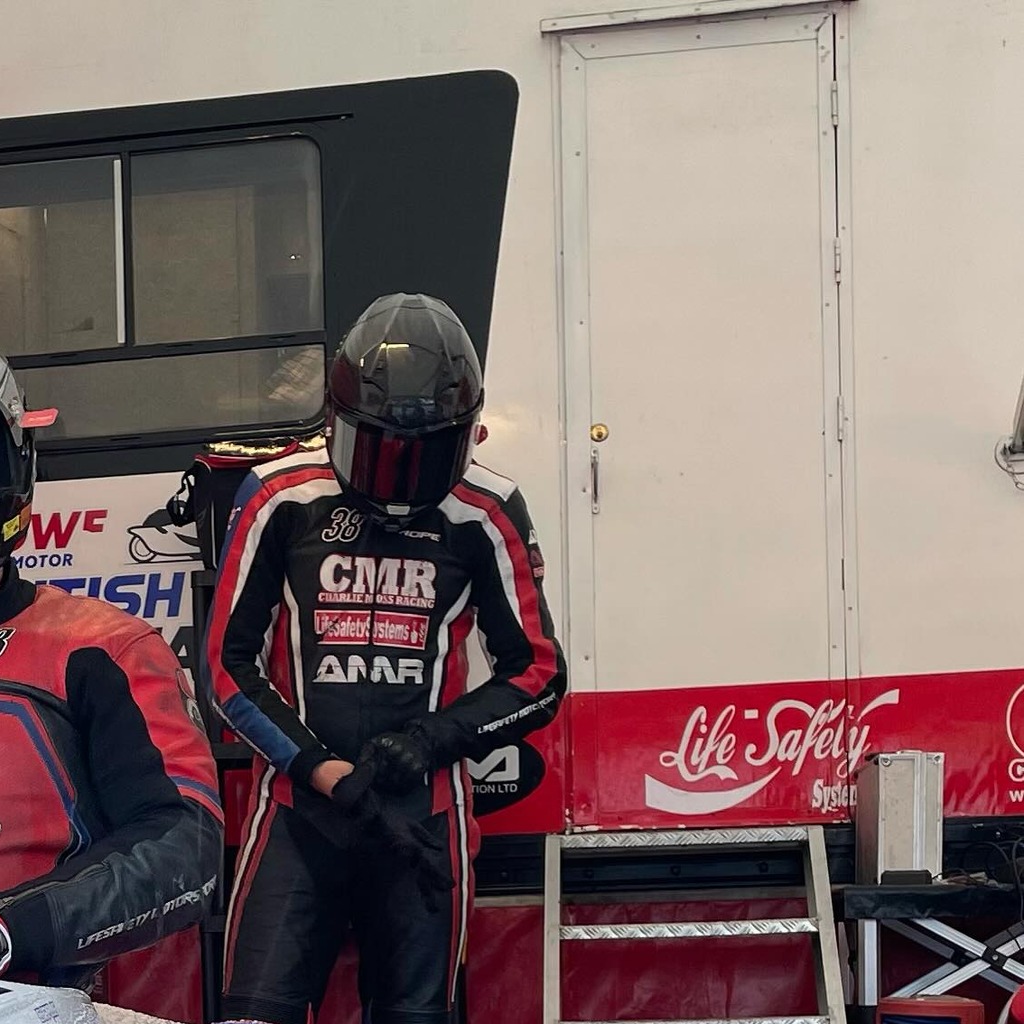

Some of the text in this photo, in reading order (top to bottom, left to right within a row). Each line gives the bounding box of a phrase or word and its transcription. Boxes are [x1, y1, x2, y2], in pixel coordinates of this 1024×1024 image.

[321, 507, 364, 542] 38
[319, 554, 437, 599] CMR
[36, 571, 186, 618] TISH
[318, 592, 436, 609] CHARLIE MOSS RACING
[312, 654, 425, 685] AMR
[497, 783, 518, 793] LTD
